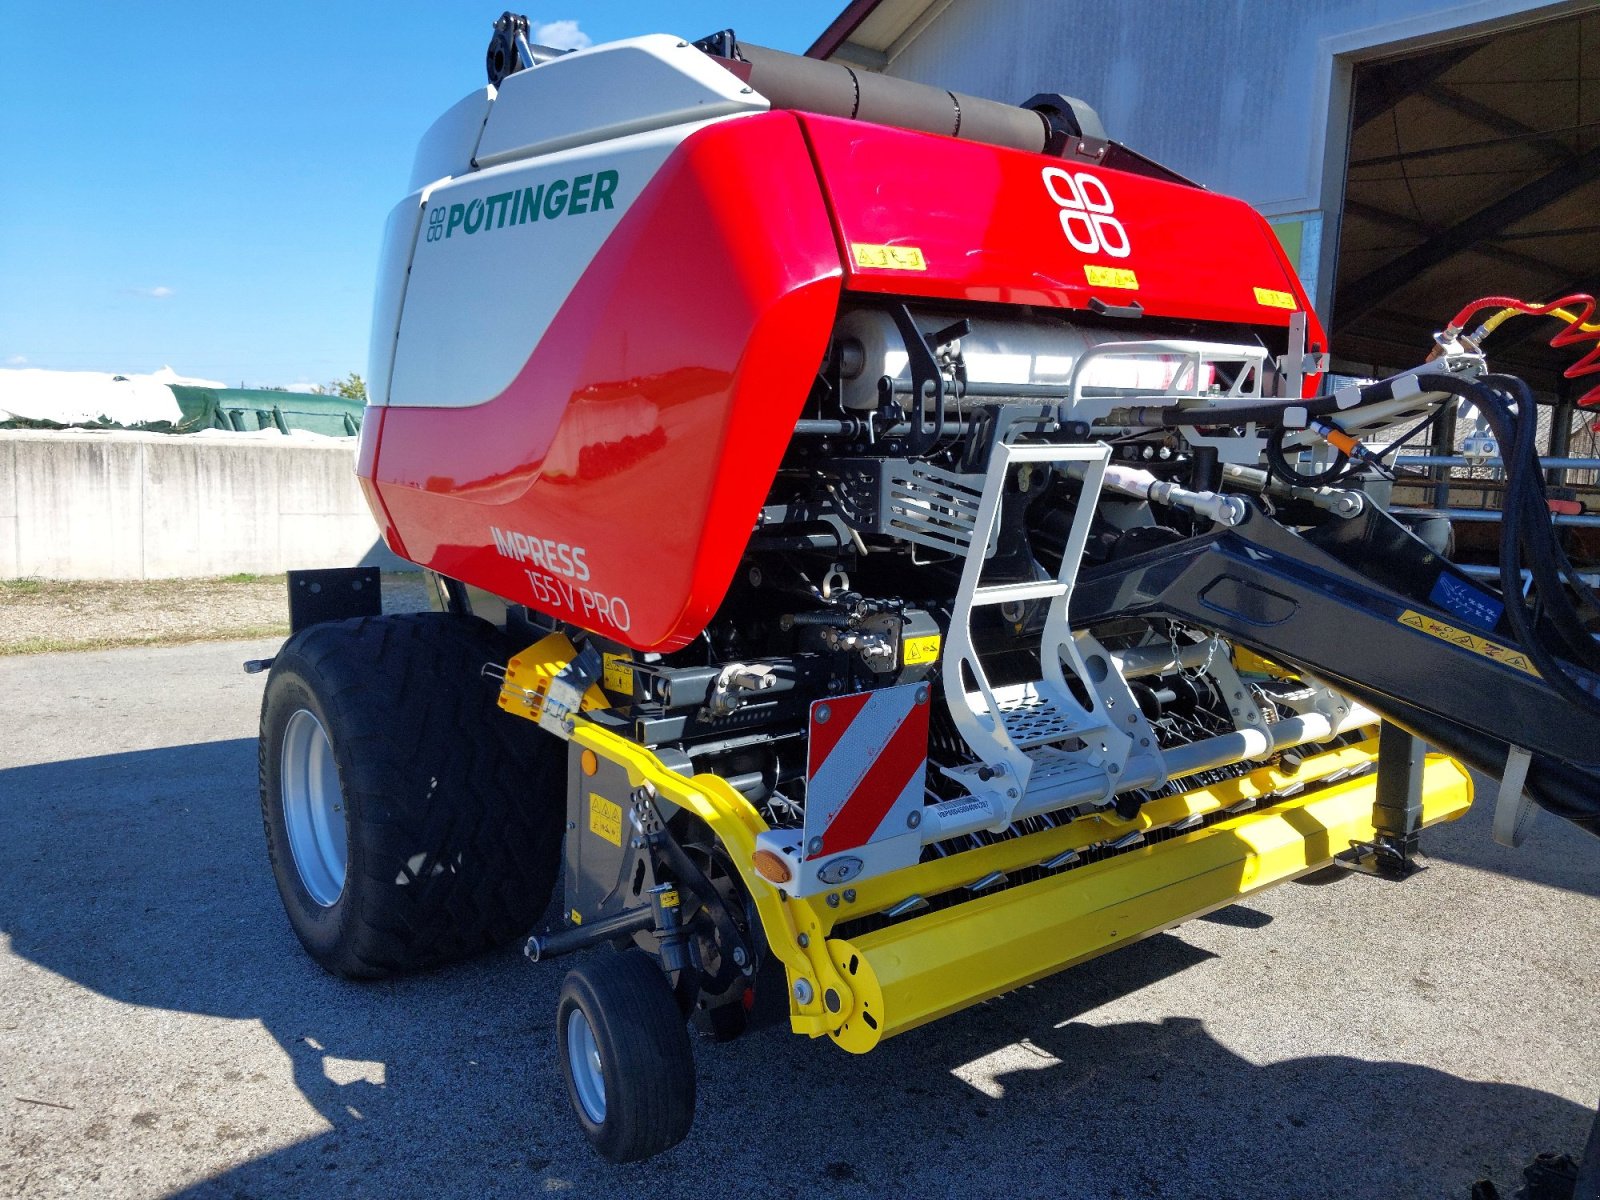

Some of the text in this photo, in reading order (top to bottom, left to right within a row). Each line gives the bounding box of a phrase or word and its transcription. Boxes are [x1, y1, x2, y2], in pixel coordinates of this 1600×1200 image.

[445, 170, 619, 238] PÖTTINGER
[490, 526, 590, 582] IMPRESS
[578, 587, 631, 632] PRO
